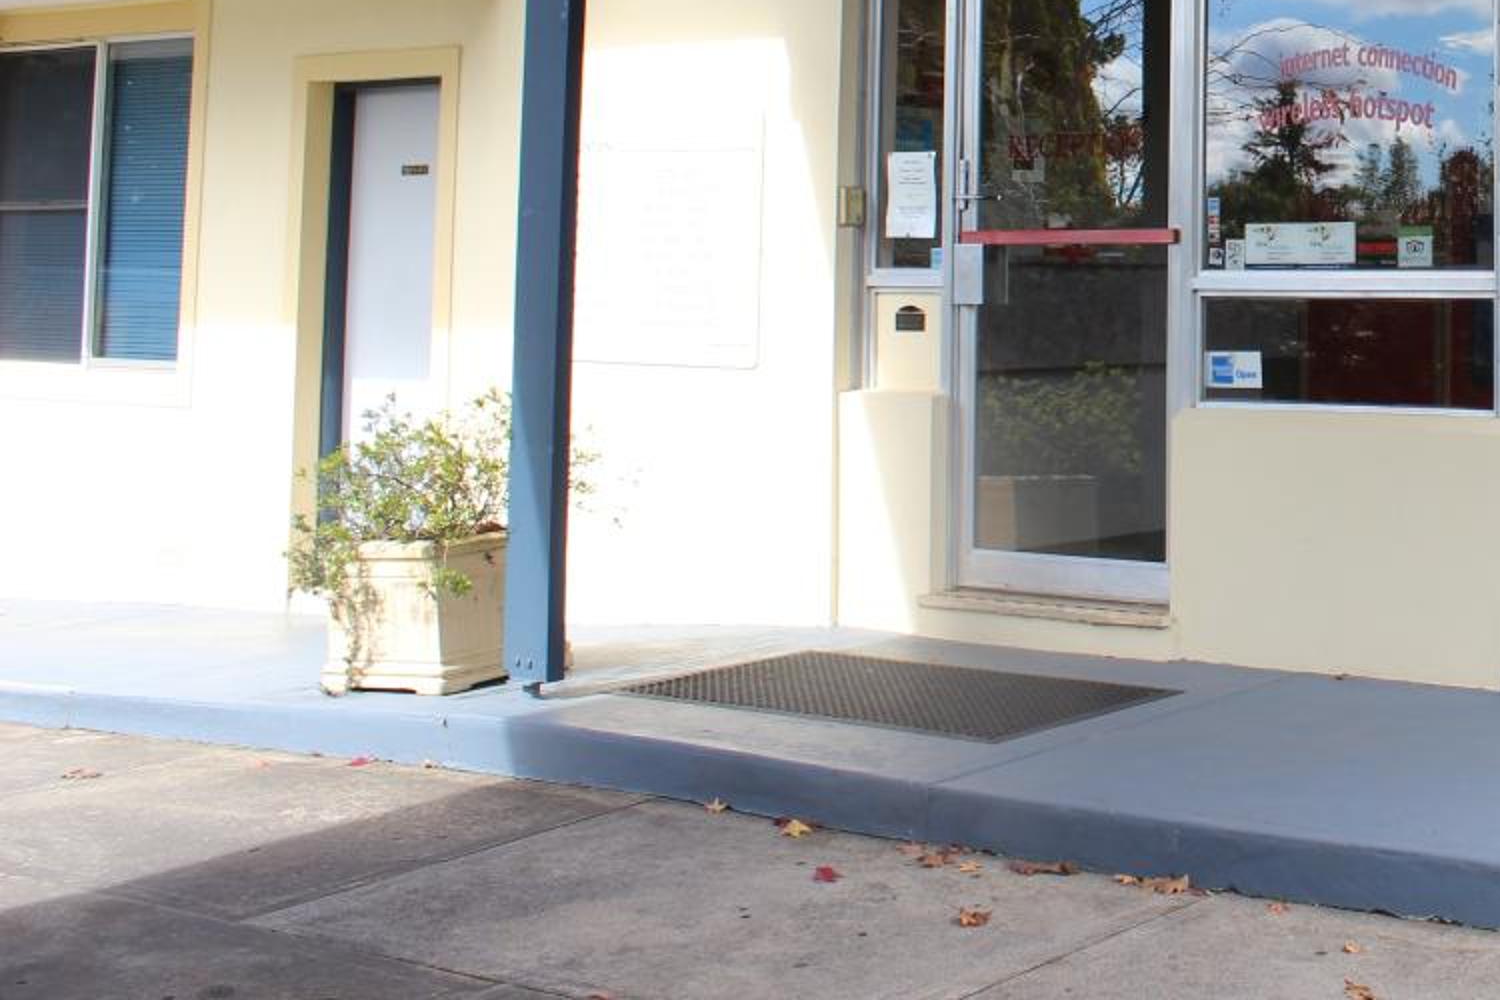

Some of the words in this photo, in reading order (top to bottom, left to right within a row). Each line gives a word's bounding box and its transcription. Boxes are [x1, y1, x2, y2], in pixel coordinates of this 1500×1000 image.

[1279, 42, 1351, 80] internet
[1356, 43, 1458, 90] connection
[1348, 88, 1436, 132] hotspot
